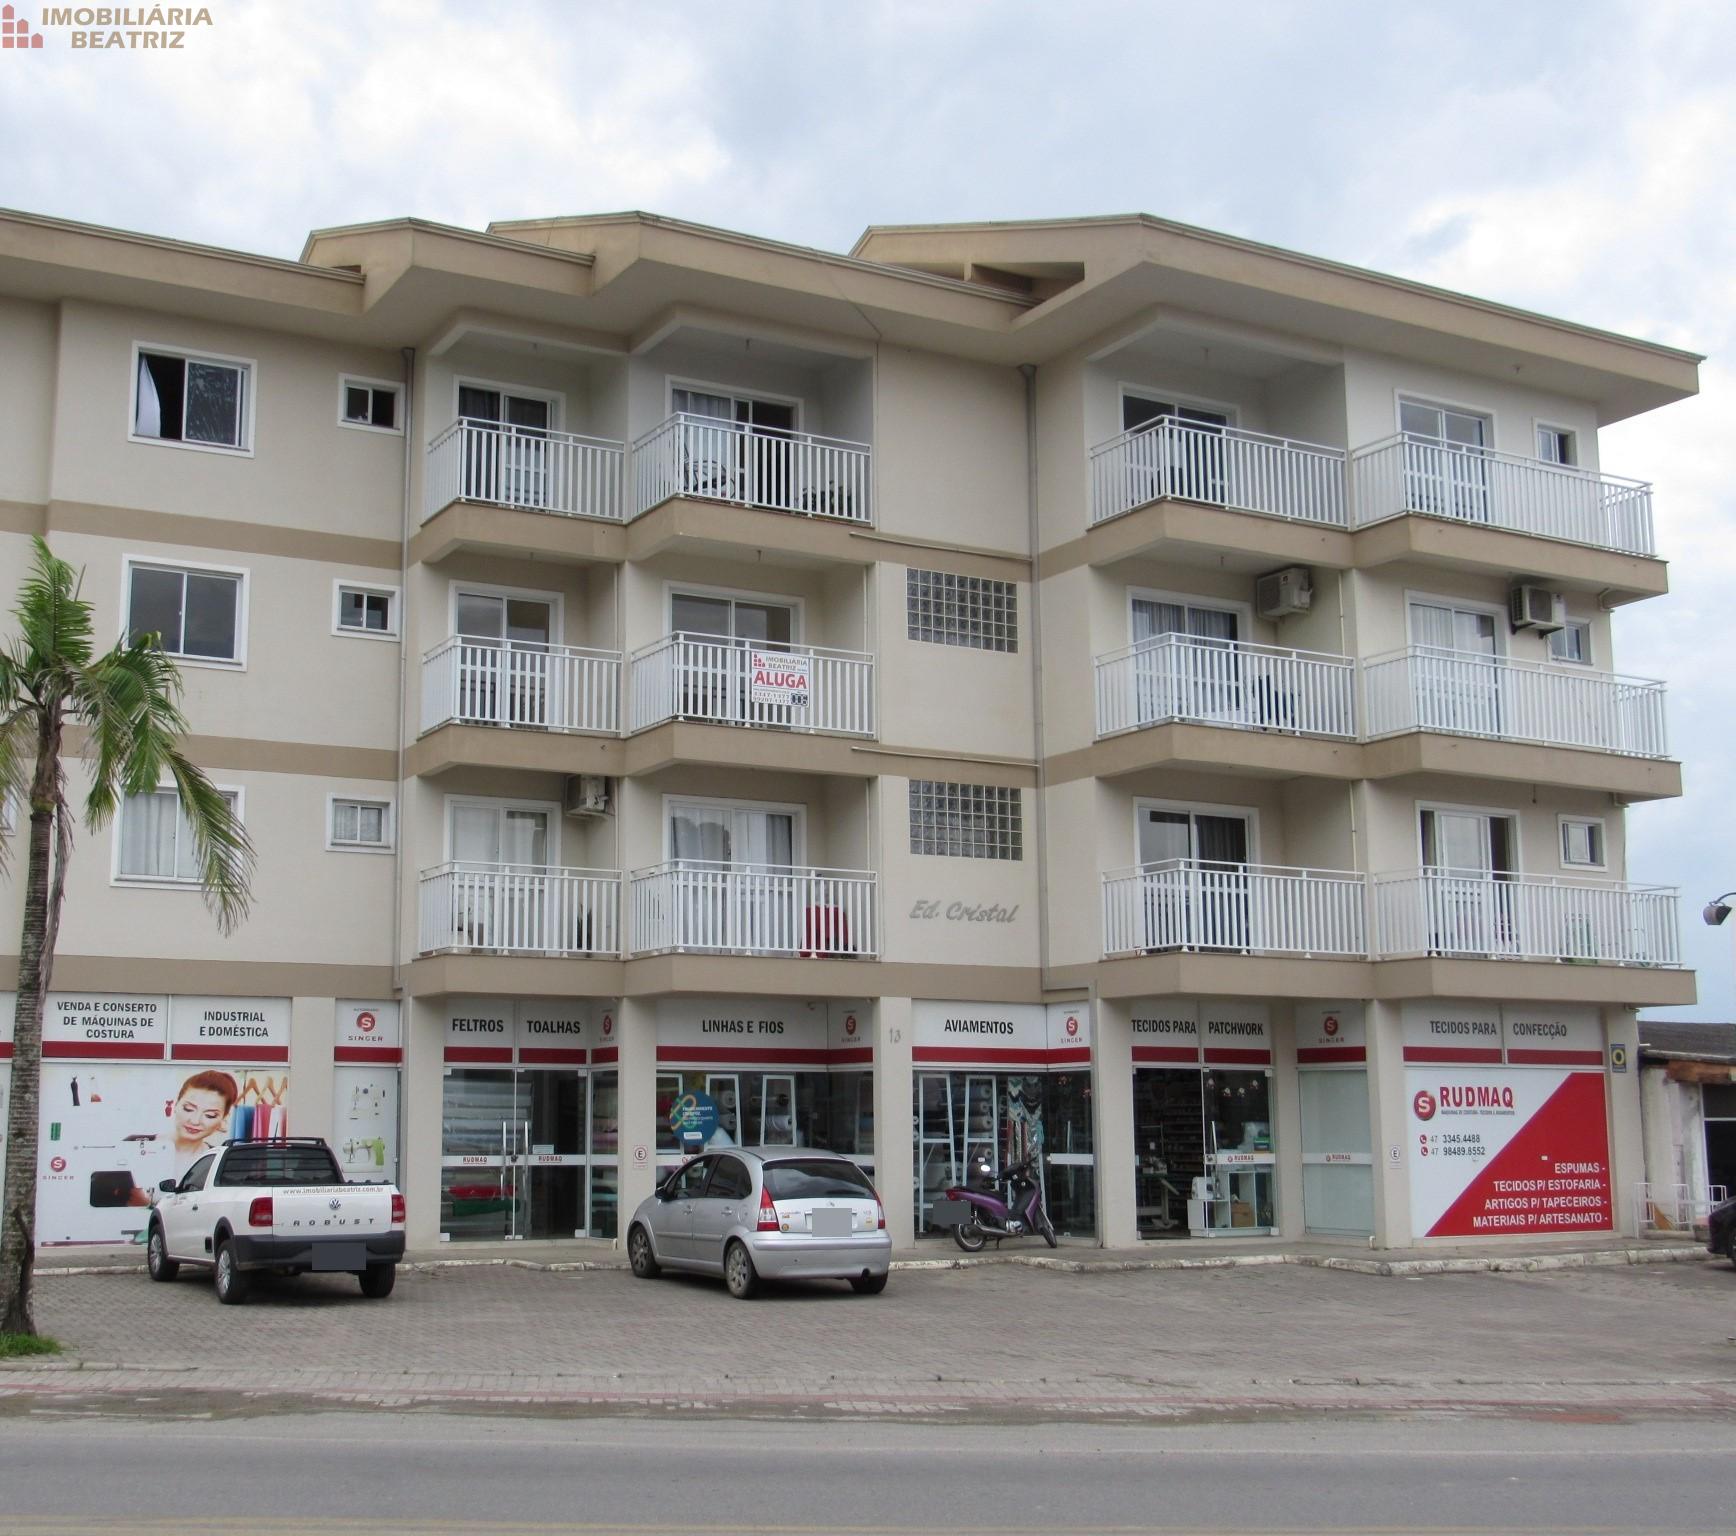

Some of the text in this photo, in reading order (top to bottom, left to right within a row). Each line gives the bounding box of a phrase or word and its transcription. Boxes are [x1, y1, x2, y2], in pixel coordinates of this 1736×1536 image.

[768, 663, 796, 671] BEATRIZ
[753, 670, 807, 689] ALUGA
[909, 899, 1020, 923] Ed. Cristal
[57, 1001, 157, 1013] VENDA E CONSERTO
[63, 1015, 154, 1027] DE MÁQUINAS DE
[204, 1011, 266, 1022] INDUSTRIAL
[199, 1025, 269, 1037] E DOMÉSTICA
[452, 1018, 504, 1033] FELTROS
[527, 1020, 581, 1034] TOALHAS
[702, 1019, 784, 1034] LINHAS E FIOS
[944, 1019, 1014, 1035] AVIAMENTOS
[1131, 1019, 1197, 1034] TECIDOS PARA
[1208, 1021, 1263, 1036] PATCHWORK
[1430, 1020, 1497, 1035] TECIDOS PARA
[1512, 1021, 1568, 1040] CONFECÇÃO
[86, 1029, 135, 1039] COSTURA
[1440, 1086, 1514, 1109] RUDMAQ
[1430, 1134, 1481, 1144] 47 3345.4488
[1431, 1147, 1439, 1156] 47
[1554, 1162, 1600, 1174] ESPUMAS
[1494, 1180, 1536, 1192] TECIDOS
[1537, 1180, 1546, 1191] P/
[1548, 1179, 1600, 1191] ESTOFARIA
[1485, 1198, 1528, 1210] ARTIGOS
[1531, 1198, 1540, 1209] P/
[1542, 1196, 1601, 1209] TAPECEIROS
[293, 1218, 374, 1227] ROBUST
[1473, 1215, 1525, 1227] MATERIAIS
[1528, 1214, 1537, 1225] P/
[1539, 1212, 1602, 1225] ARTESANATO
